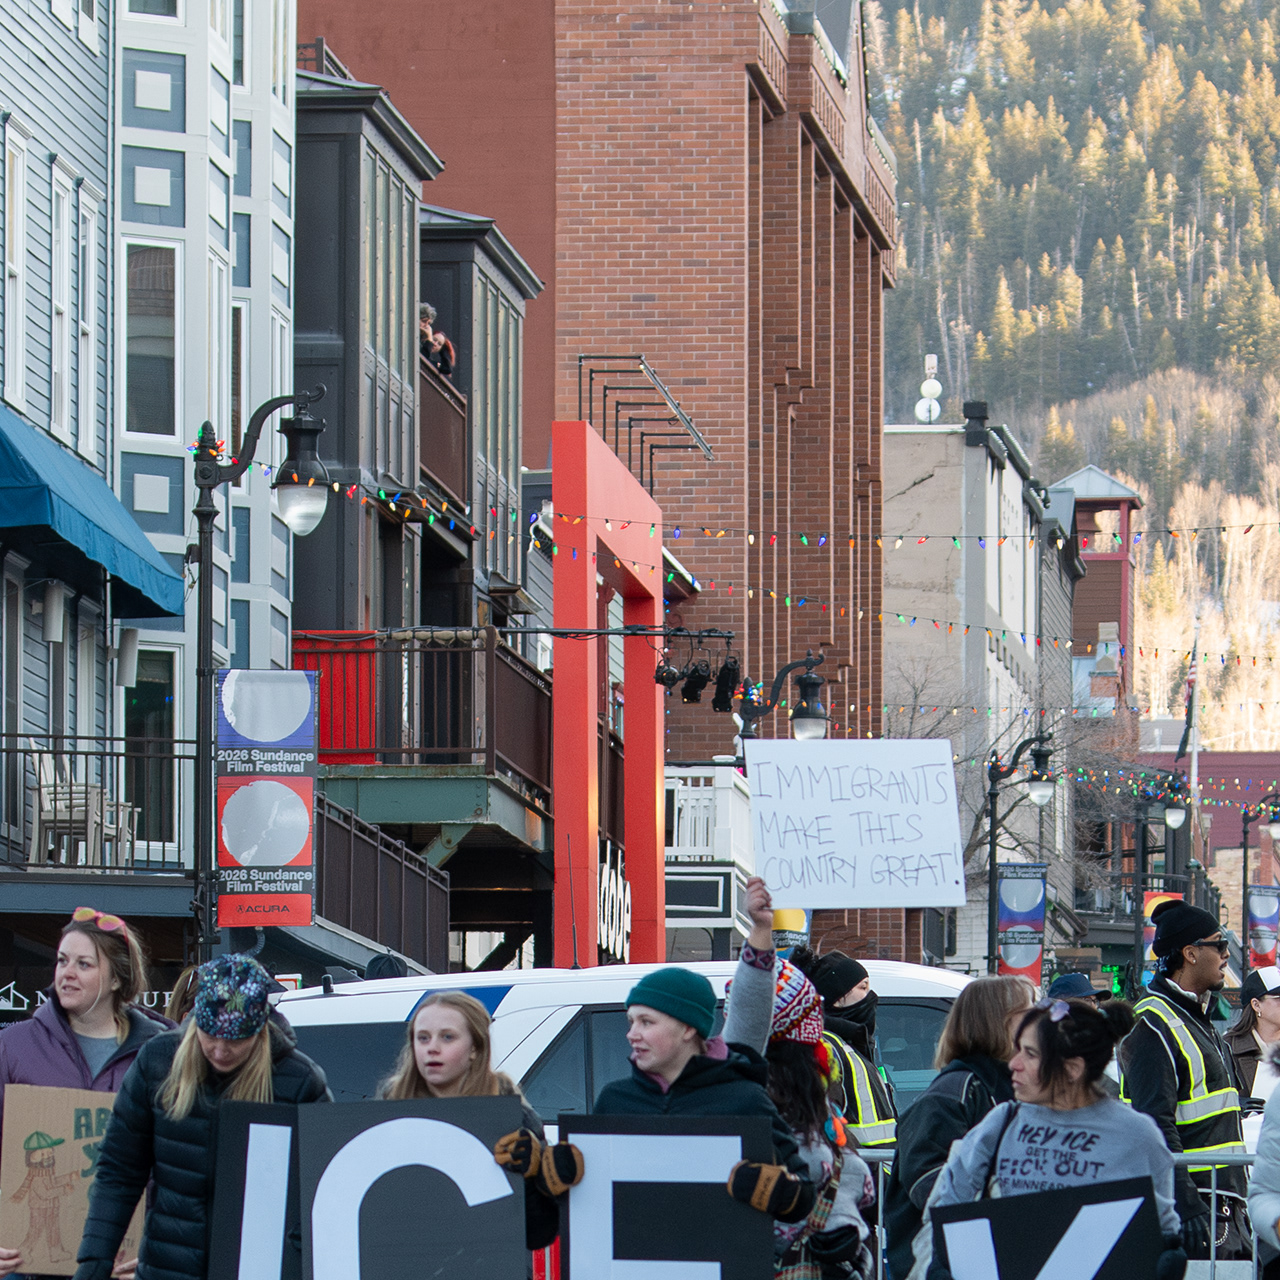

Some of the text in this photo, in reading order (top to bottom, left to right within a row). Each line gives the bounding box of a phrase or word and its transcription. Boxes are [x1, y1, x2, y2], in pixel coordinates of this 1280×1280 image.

[217, 750, 314, 762] 2026 Sundance
[226, 761, 304, 773] Film Festival
[752, 761, 948, 805] IMMIGRANTS
[759, 811, 923, 852] MAKE THIS
[219, 869, 313, 881] 2026 Sundance
[763, 842, 960, 892] COUNTRY GREAT!
[226, 880, 303, 892] Film Festival
[245, 904, 290, 914] ACURA
[597, 836, 632, 965] dobe
[1017, 1123, 1101, 1153] HEY ICE
[1025, 1146, 1078, 1162] GET THE
[1054, 1159, 1106, 1179] OUT
